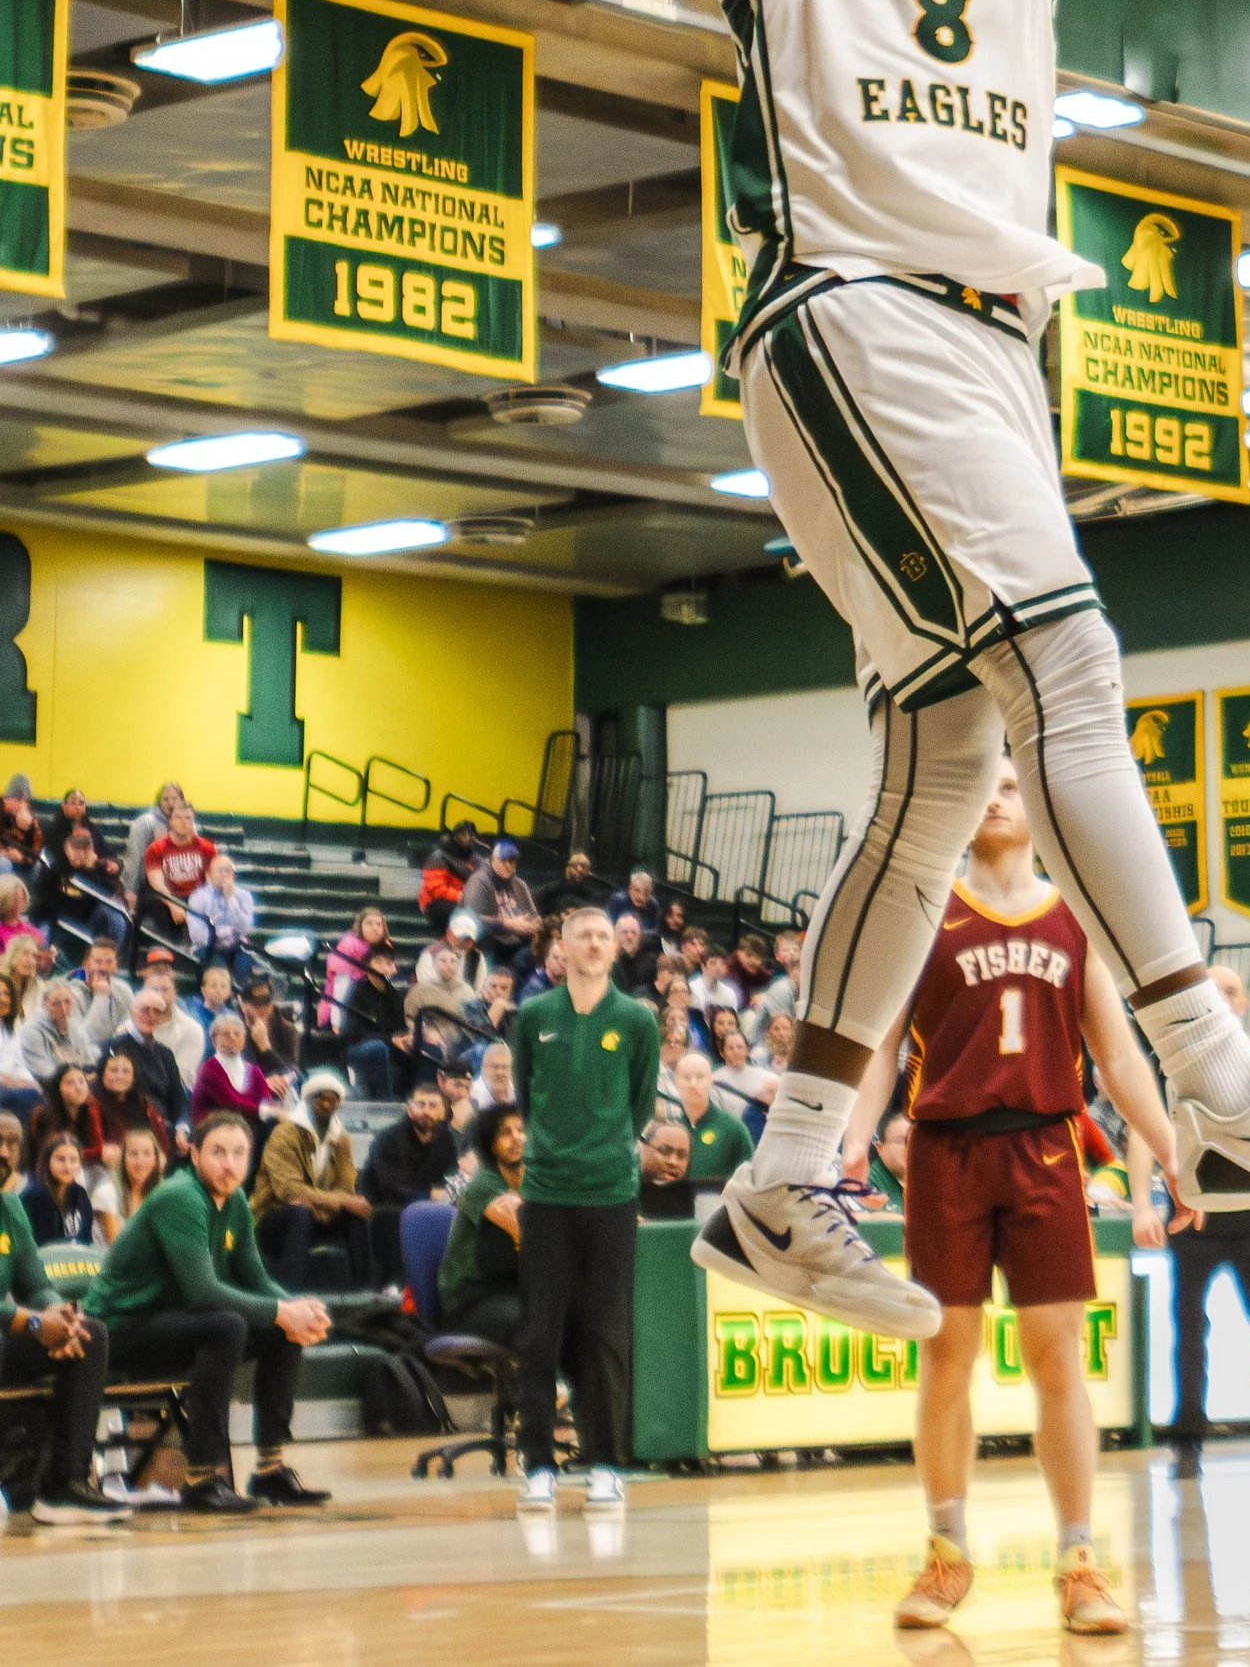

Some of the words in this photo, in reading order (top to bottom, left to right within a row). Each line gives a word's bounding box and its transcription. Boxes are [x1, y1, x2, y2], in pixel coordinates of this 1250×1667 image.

[855, 75, 1028, 153] EAGLES
[343, 138, 469, 184] WRESTLING
[304, 165, 374, 202] NCAA
[380, 180, 505, 230] NATIONAL
[304, 197, 506, 267] CHAMPIONS
[333, 258, 478, 341] 1982
[1112, 304, 1203, 339] WRESTLING
[1083, 330, 1134, 357] NCAA
[1139, 341, 1227, 375] NATIONAL
[1085, 356, 1230, 407] CHAMPIONS
[1109, 407, 1214, 471] 1992
[955, 937, 1072, 989] FISHER
[998, 986, 1026, 1055] 1
